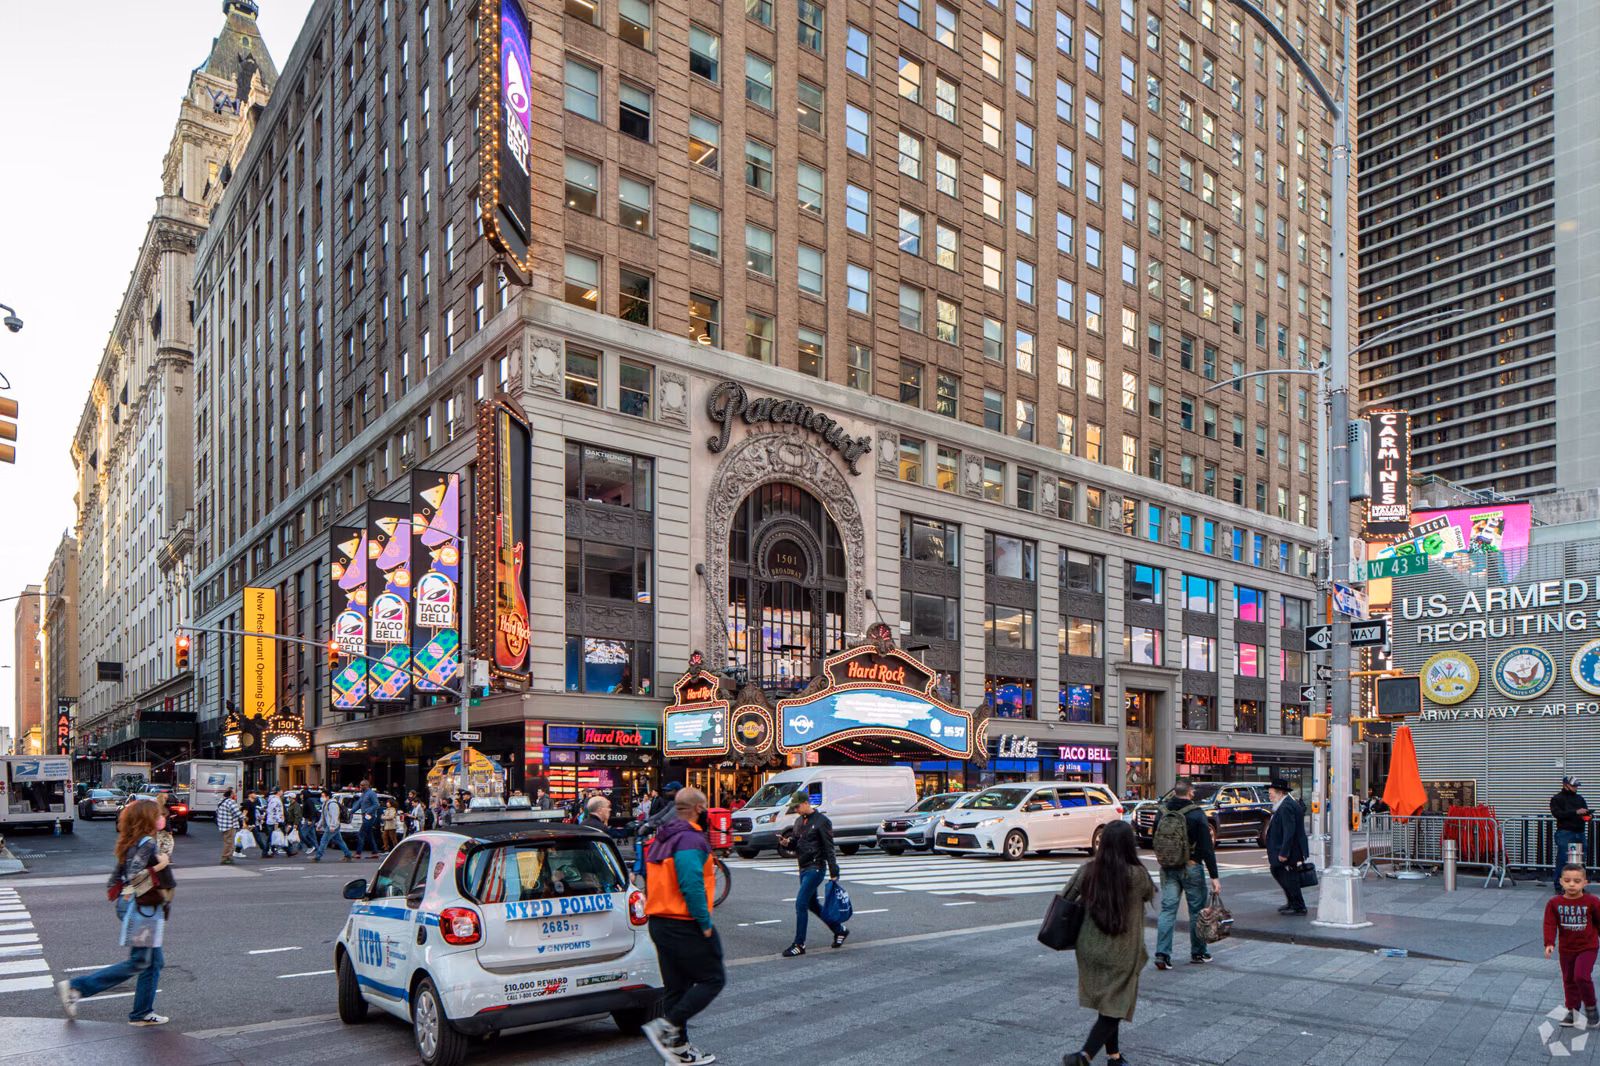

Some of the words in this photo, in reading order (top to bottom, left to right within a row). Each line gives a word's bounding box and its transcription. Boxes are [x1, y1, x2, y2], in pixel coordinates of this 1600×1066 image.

[505, 103, 529, 155] TACO
[506, 126, 529, 177] BELL
[707, 381, 872, 476] Paramount
[1378, 414, 1400, 505] CARMINES
[1419, 518, 1446, 534] BECK
[776, 553, 797, 566] 1501
[1371, 561, 1384, 578] W
[1391, 558, 1409, 575] 43
[1415, 555, 1426, 567] St
[770, 567, 803, 579] BROADWAY
[256, 591, 265, 611] New
[1403, 594, 1453, 620] U.S.
[1459, 579, 1588, 614] ARMED
[419, 603, 450, 613] TACO
[374, 621, 403, 630] TACO
[421, 613, 449, 623] BELL
[375, 630, 402, 639] BELL
[500, 614, 516, 635] Hard
[516, 620, 532, 644] Rock
[1417, 609, 1587, 644] RECRUITING
[256, 613, 265, 660] Resturant
[337, 636, 363, 645] TACO
[1317, 632, 1332, 643] ON
[1351, 628, 1376, 641] WAY
[339, 645, 363, 653] BELL
[848, 661, 876, 679] Hard
[877, 665, 905, 684] Rock
[254, 663, 265, 699] Opening
[687, 687, 702, 700] Hard
[256, 701, 265, 713] So
[1419, 709, 1460, 721] ARMY
[1473, 706, 1520, 719] NAVY
[1541, 704, 1566, 716] AIR
[1576, 703, 1599, 715] FO
[58, 705, 69, 757] PARKI
[277, 721, 295, 729] 1501
[586, 729, 615, 743] Hard
[615, 730, 643, 746] Rock
[999, 733, 1038, 758] Lids
[585, 753, 606, 761] ROCK
[1058, 746, 1086, 760] TACO
[1087, 747, 1112, 761] BELL
[1184, 744, 1210, 764] BUBBA
[505, 900, 553, 919] NYPD
[559, 893, 614, 915] POLICE
[1558, 905, 1588, 915] GREAT
[542, 920, 570, 934] 2685
[1560, 915, 1588, 924] TIMES
[358, 928, 383, 967] NYPD
[547, 941, 591, 953] @NYPDMTS
[504, 982, 535, 992] $10,000
[537, 977, 568, 987] REWARD
